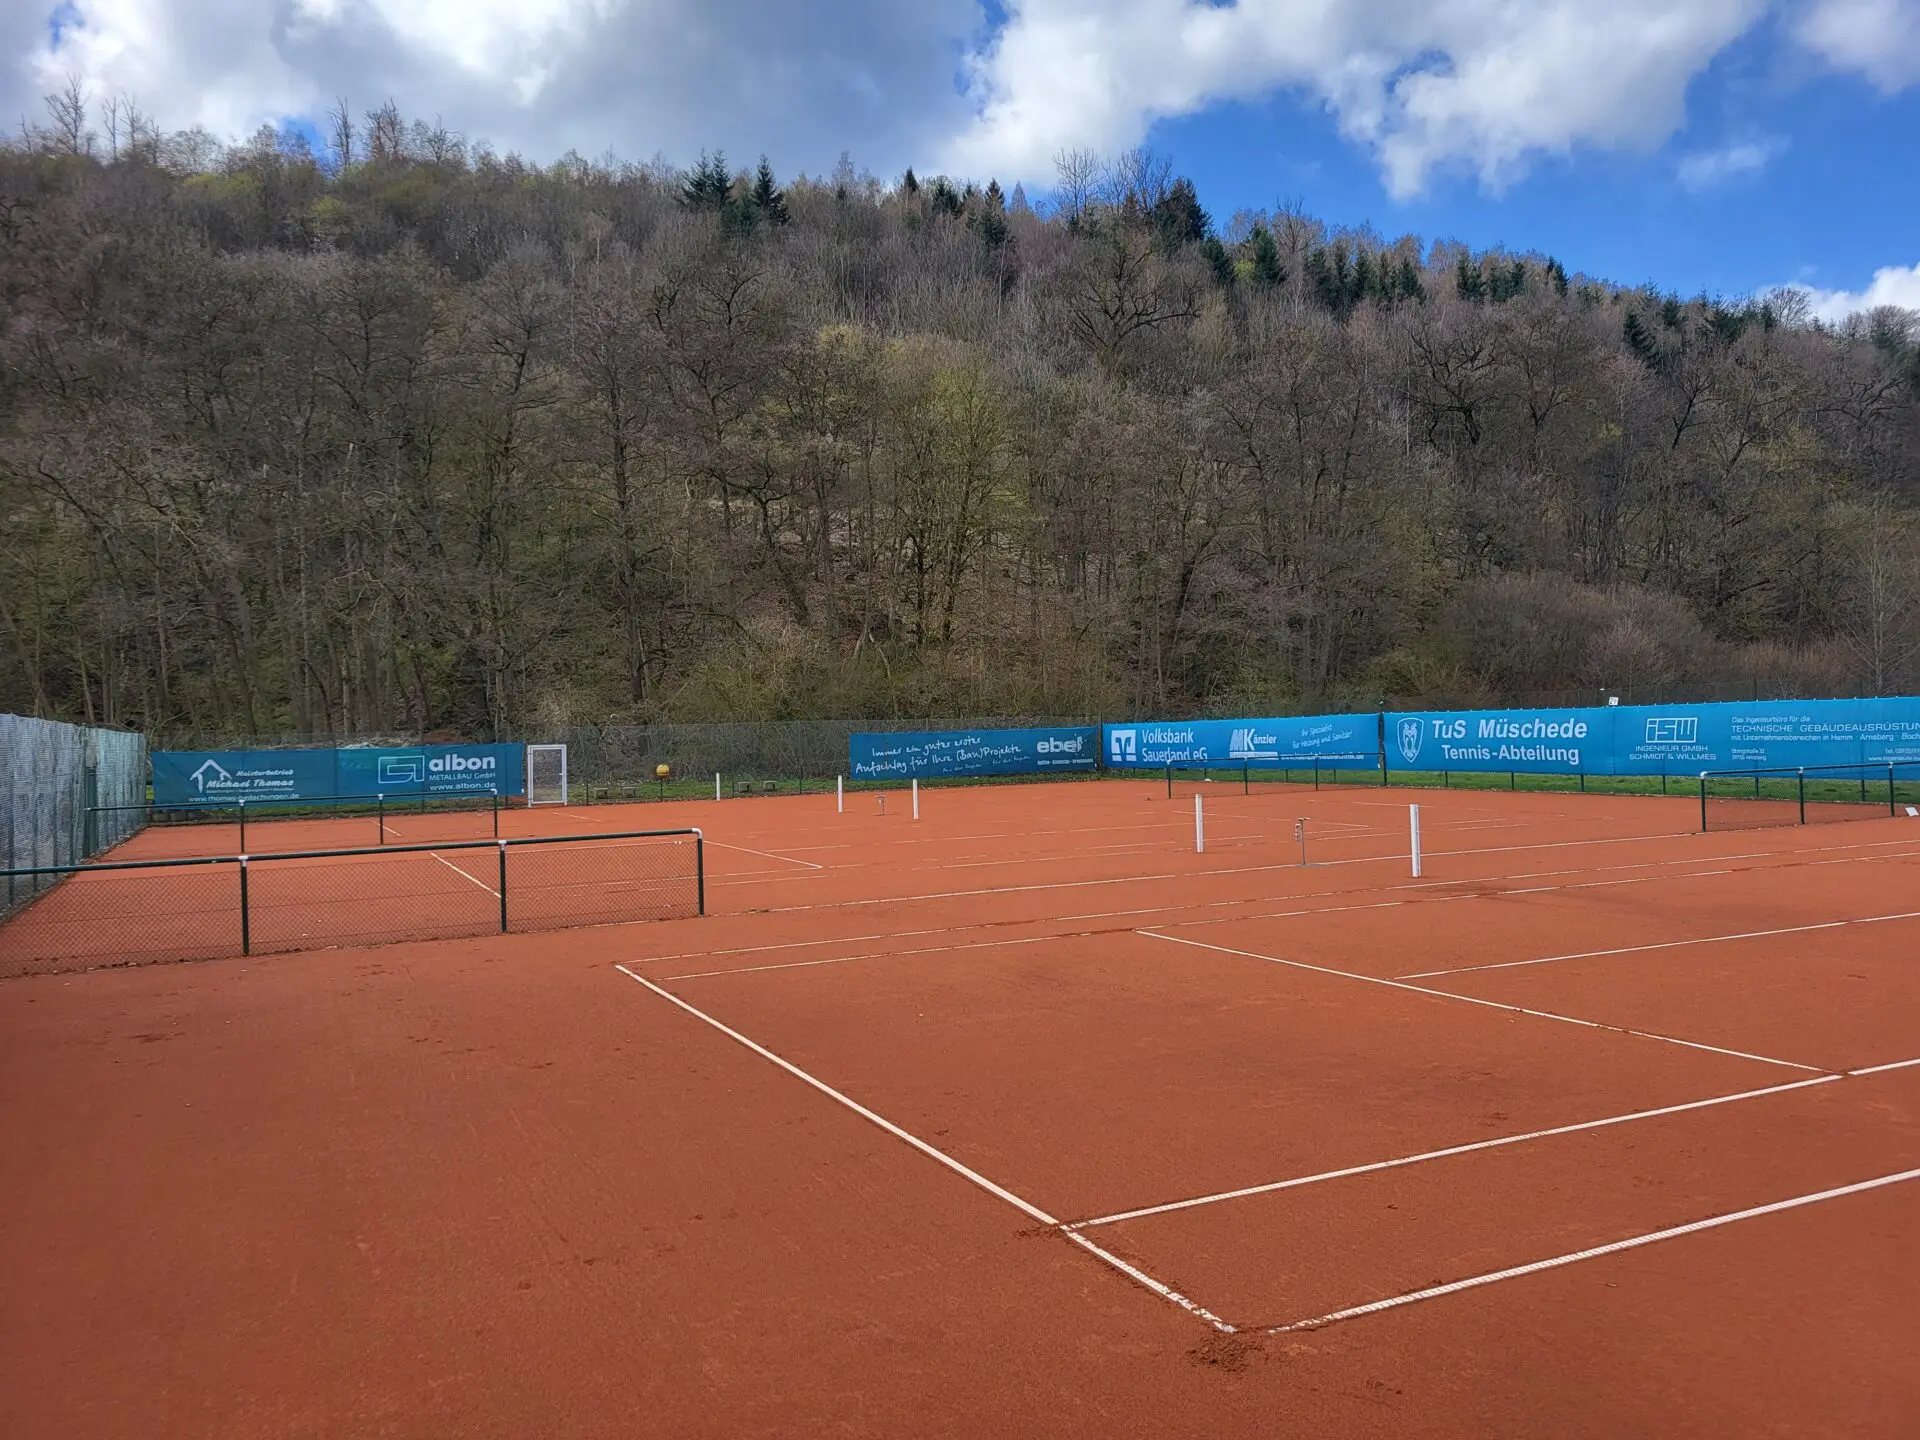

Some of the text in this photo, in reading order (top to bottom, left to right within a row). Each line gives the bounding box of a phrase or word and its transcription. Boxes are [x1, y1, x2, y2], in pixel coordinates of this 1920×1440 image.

[1142, 728, 1194, 744] Volksbank
[1432, 718, 1588, 739] TuS Müschede
[1731, 725, 1793, 733] TECHNISCHE
[1860, 734, 1894, 742] Arnsberg
[872, 748, 902, 756] Immer
[924, 740, 952, 755] guter
[954, 736, 982, 749] erster
[1142, 747, 1208, 762] Sauerland eG
[1441, 744, 1580, 765] Tennis-Abteilung
[428, 754, 496, 772] albon
[855, 760, 907, 777] Aufschlag
[910, 756, 928, 771] für
[932, 754, 952, 764] Ihre
[236, 769, 294, 777] Meisterbetrieb
[206, 780, 250, 788] Michael
[430, 782, 496, 791] www.albon.de
